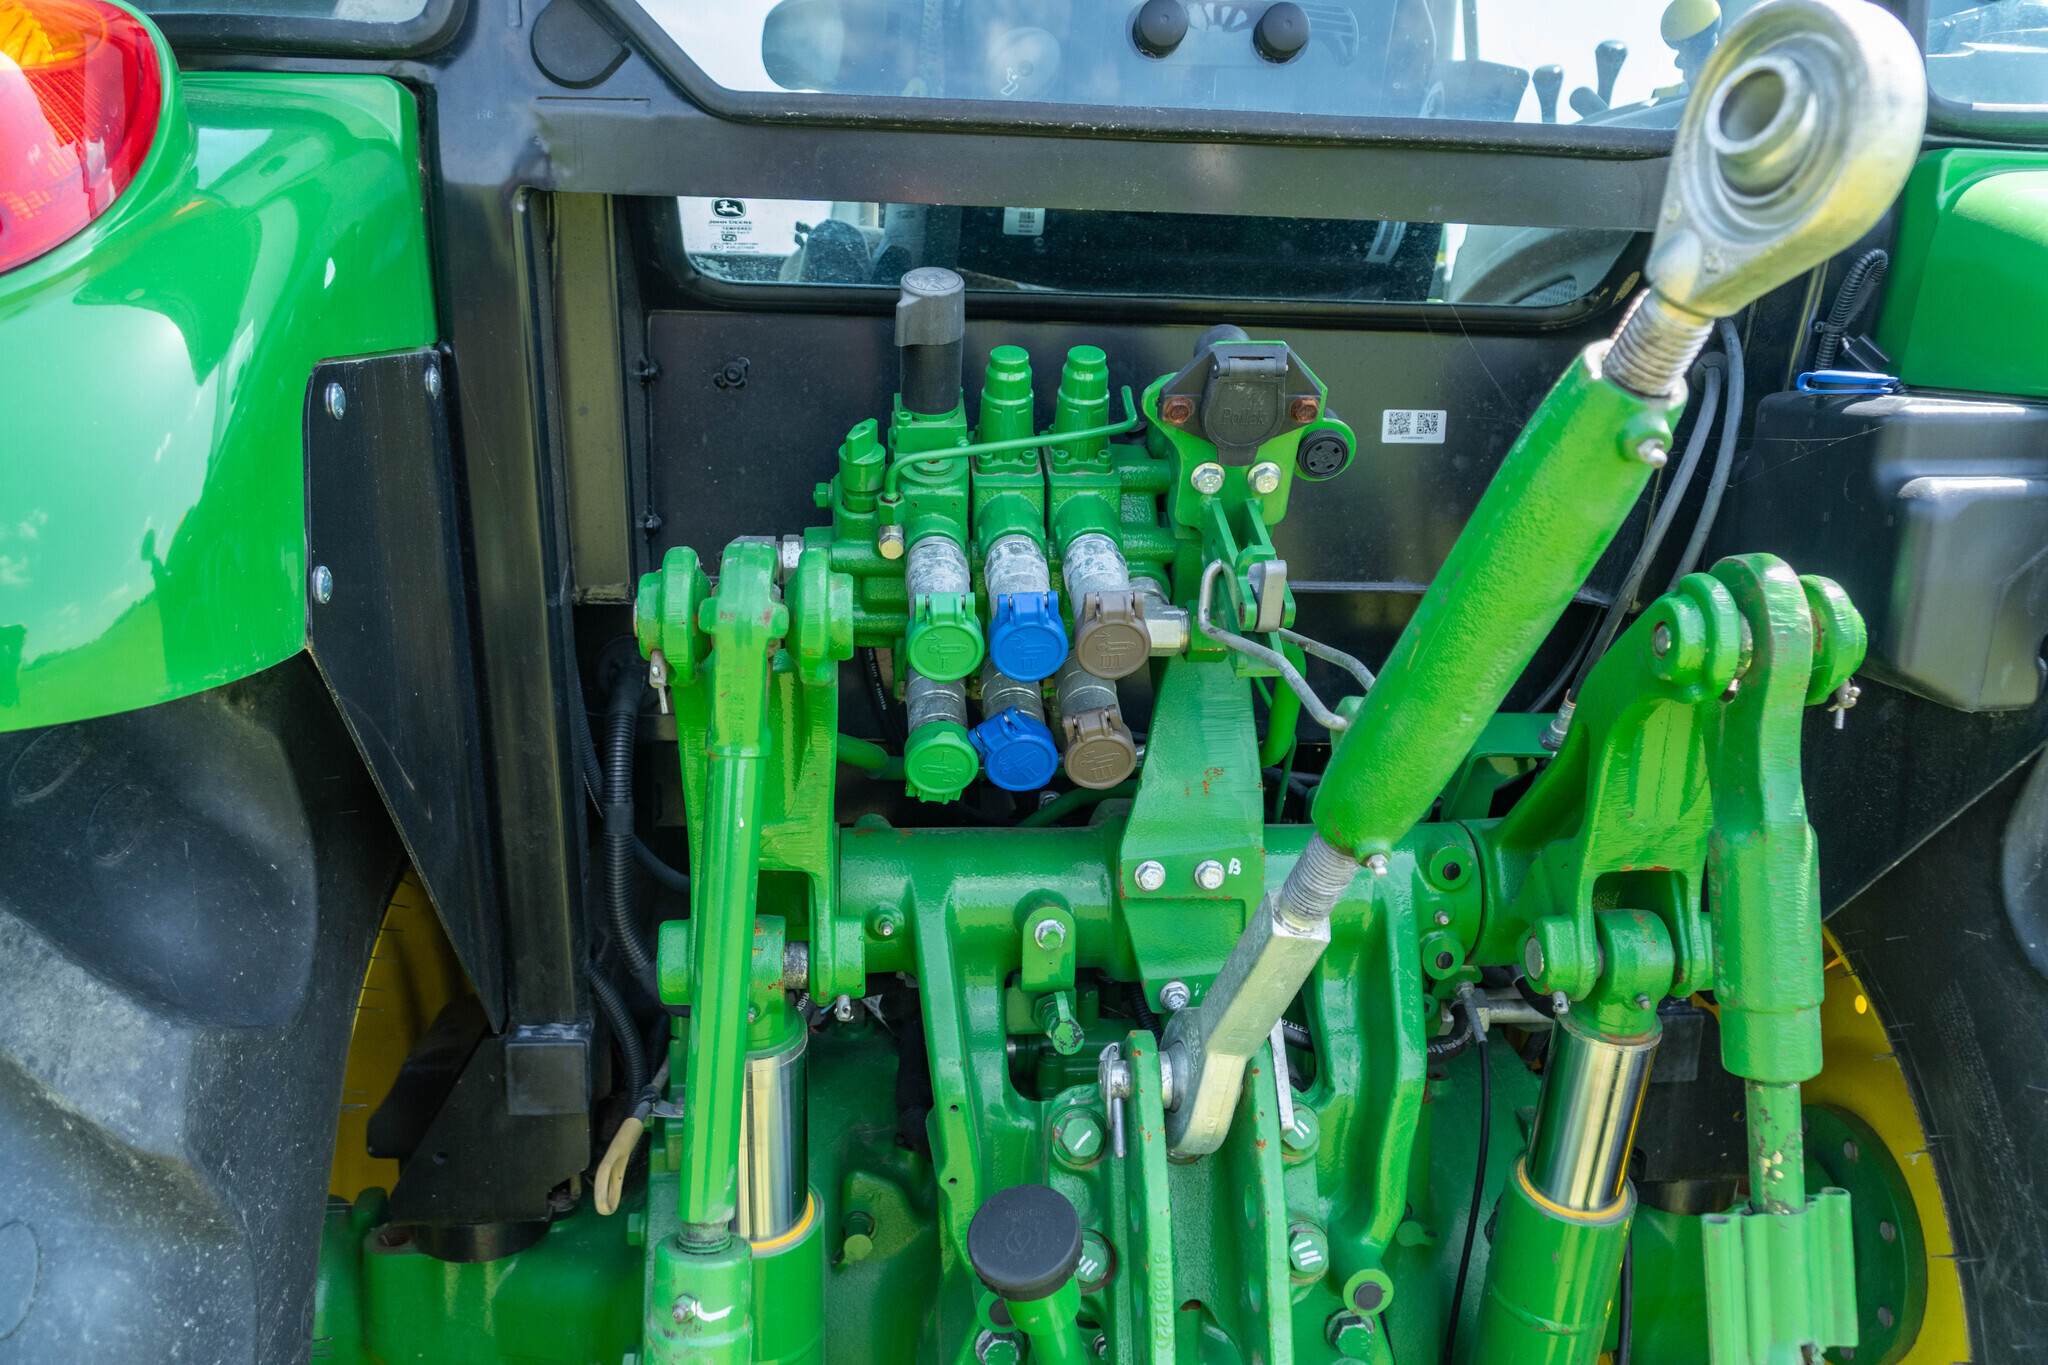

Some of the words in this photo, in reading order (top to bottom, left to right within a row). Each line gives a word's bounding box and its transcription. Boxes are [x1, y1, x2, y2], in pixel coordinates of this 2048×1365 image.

[1221, 407, 1268, 425] Pollak
[1100, 654, 1125, 669] III
[1090, 764, 1116, 781] III
[1228, 857, 1242, 876] B
